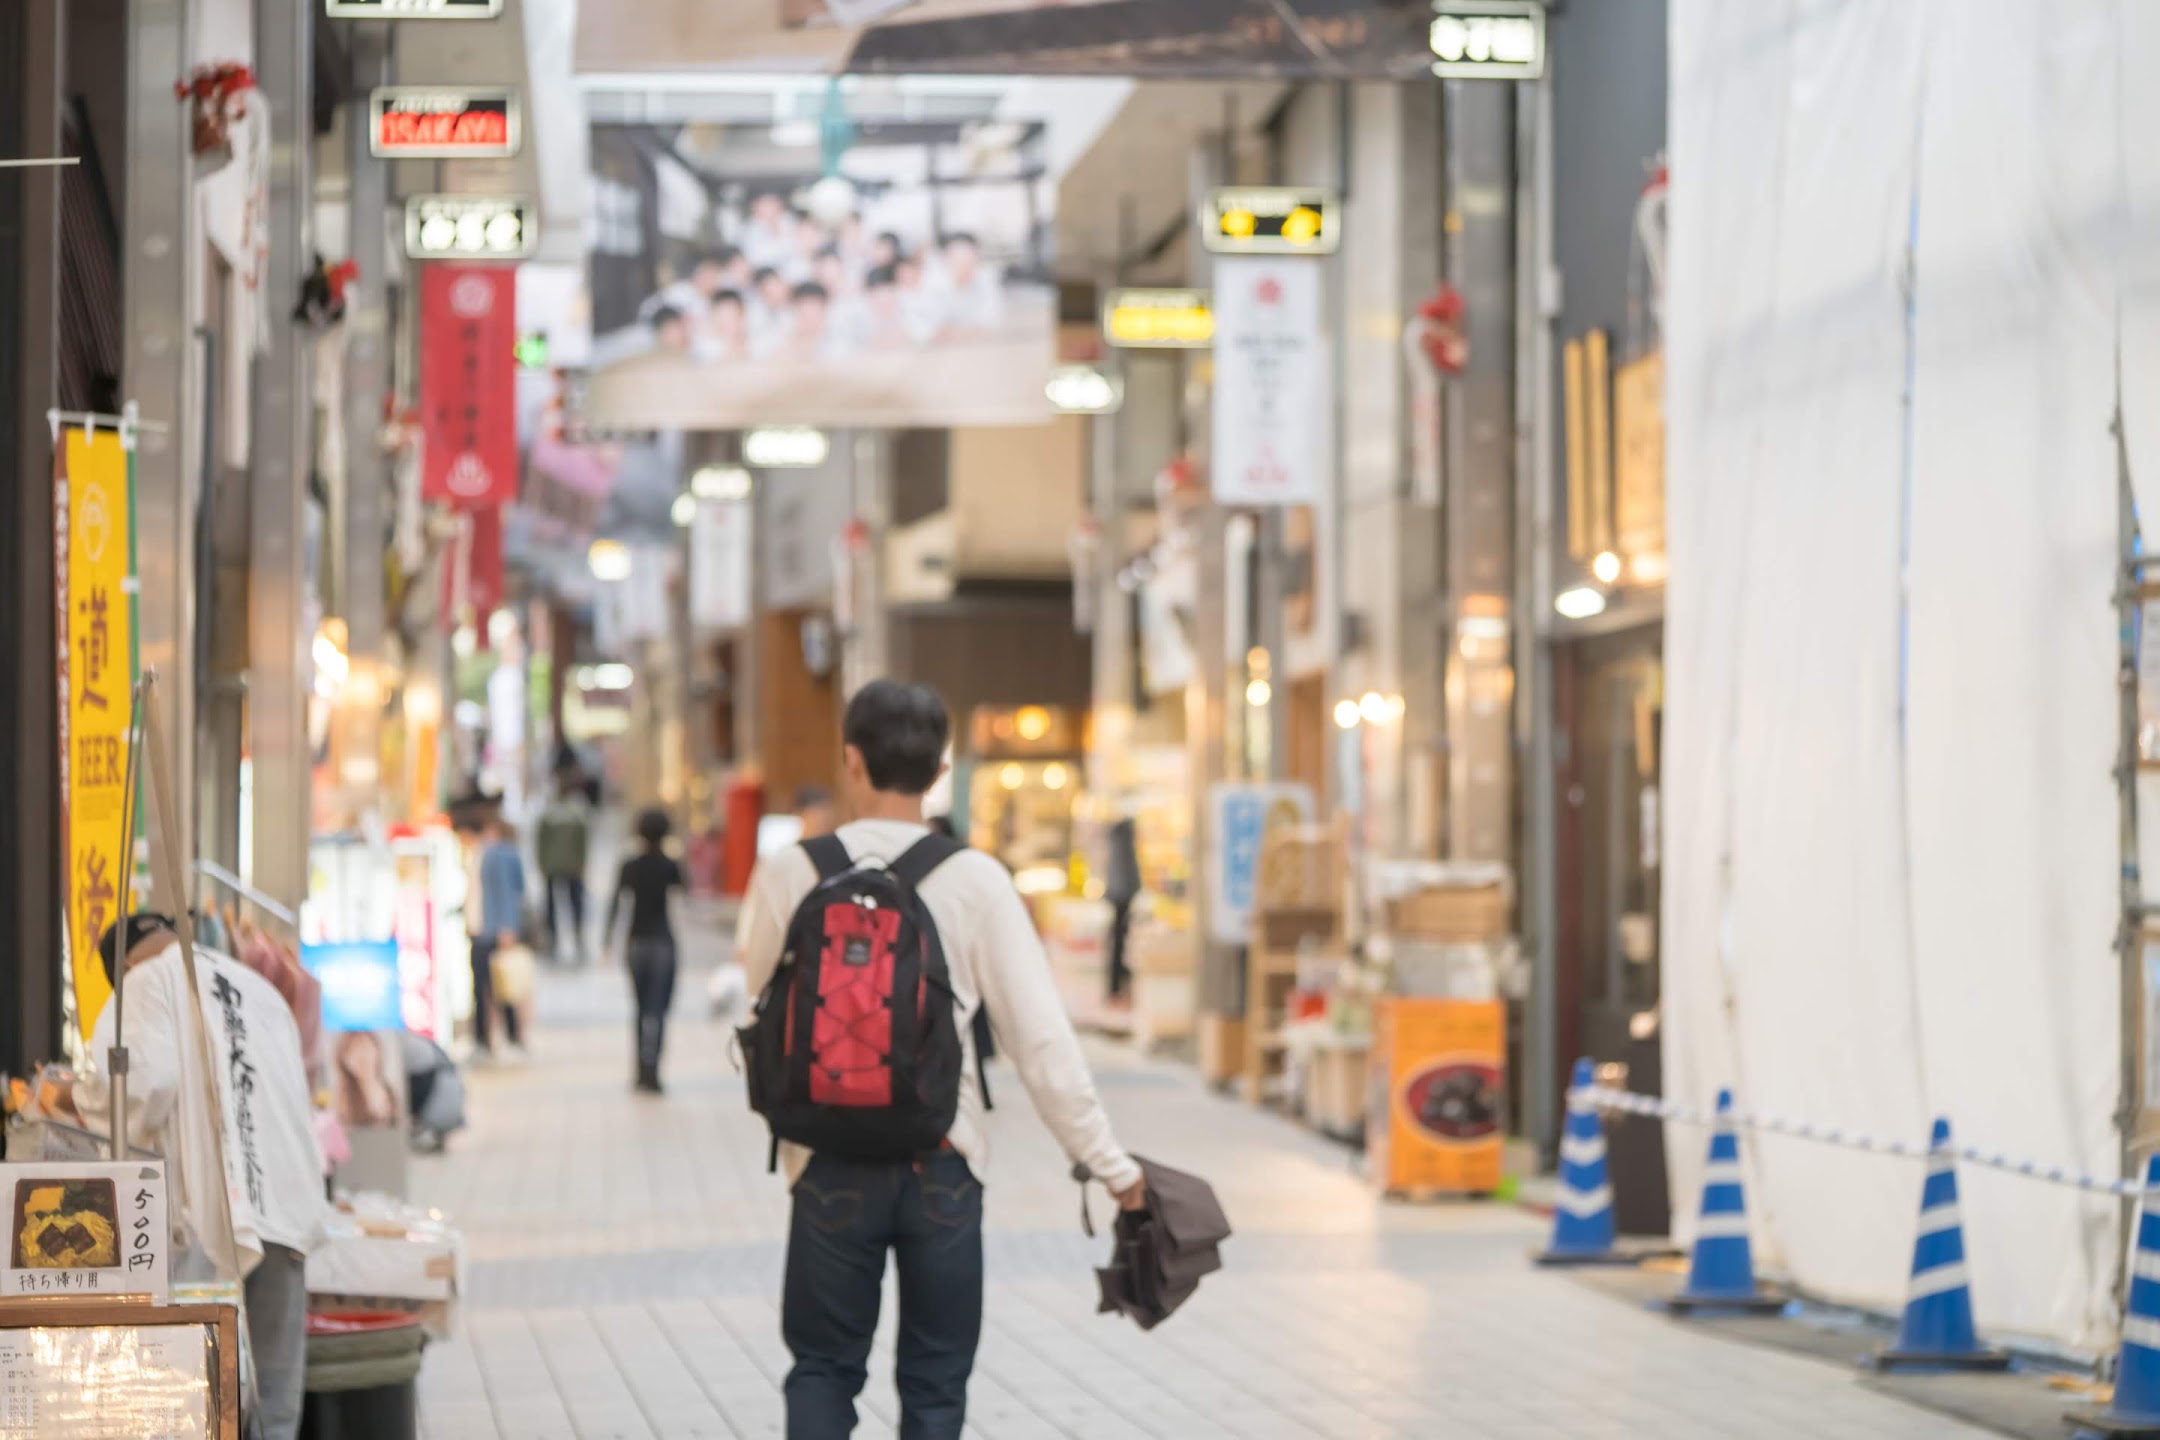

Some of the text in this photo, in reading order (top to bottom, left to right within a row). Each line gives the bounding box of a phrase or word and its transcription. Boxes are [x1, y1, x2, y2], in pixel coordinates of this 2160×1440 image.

[18, 1271, 99, 1292] 持ち帰り用
